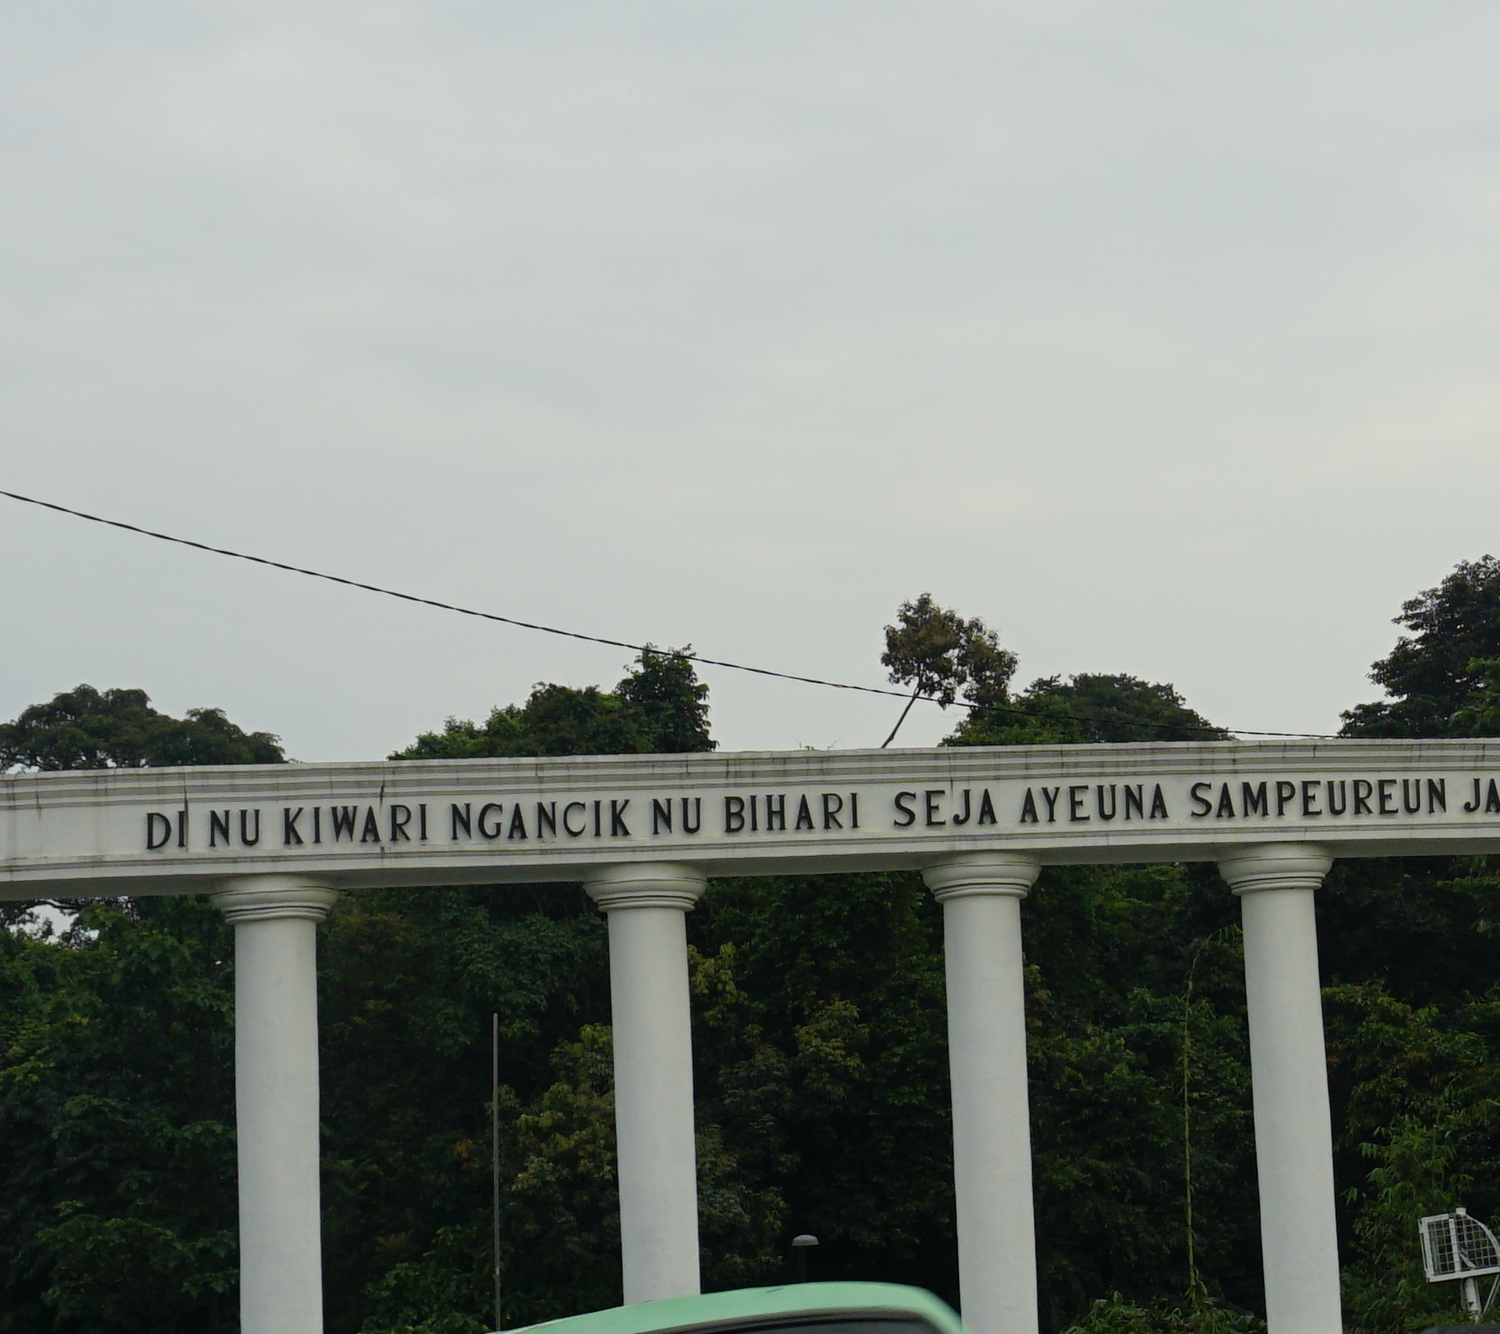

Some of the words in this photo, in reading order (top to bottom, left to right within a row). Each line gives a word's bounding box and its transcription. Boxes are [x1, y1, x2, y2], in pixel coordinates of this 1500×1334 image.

[146, 810, 187, 850] DI
[209, 808, 261, 848] NU
[283, 803, 428, 845] KIWARI
[451, 798, 631, 841] NGANCIK
[652, 797, 702, 835] NU
[724, 792, 860, 833] BIHARI
[893, 788, 998, 827] SEJA
[1020, 783, 1169, 823] AYEUNA
[1190, 778, 1447, 818] SAMPEUREUN
